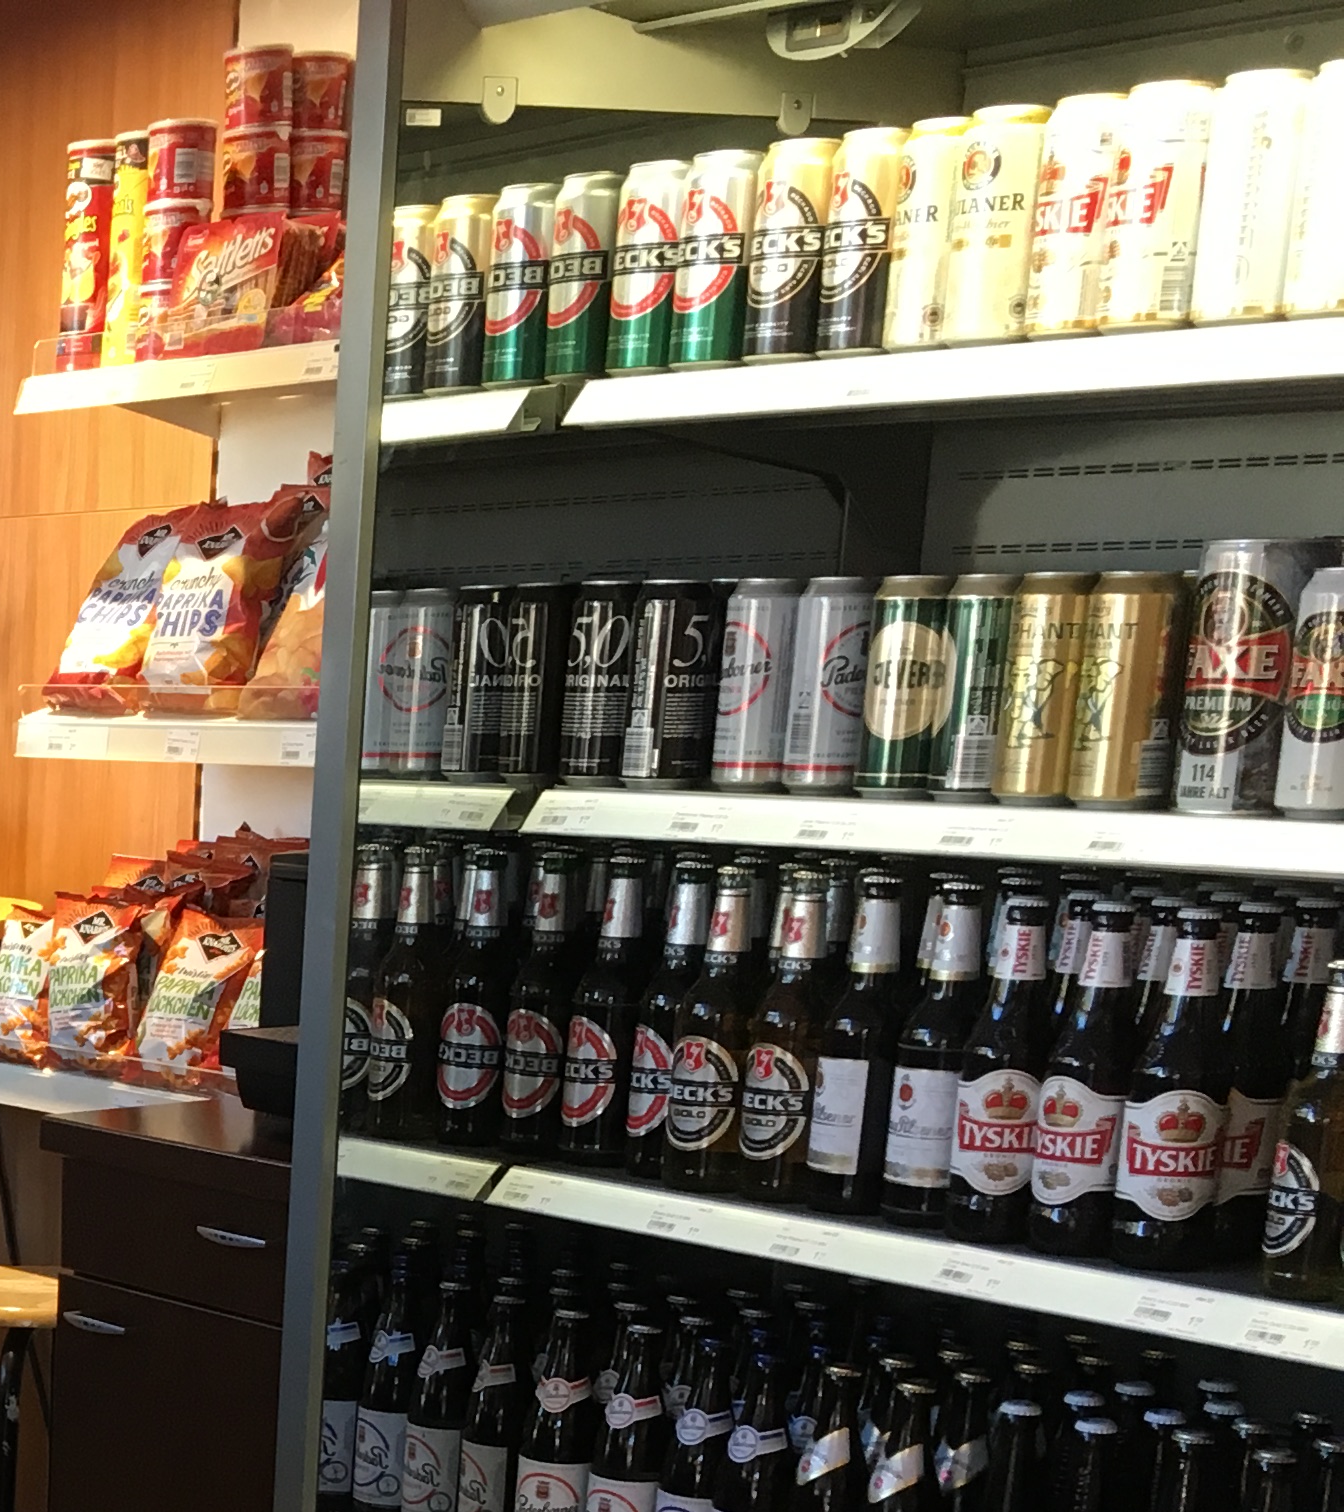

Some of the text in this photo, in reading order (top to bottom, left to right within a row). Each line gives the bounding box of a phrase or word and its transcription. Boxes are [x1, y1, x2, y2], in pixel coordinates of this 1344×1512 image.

[752, 227, 821, 256] ECK'S
[824, 218, 887, 248] ECK'S
[195, 226, 276, 290] Saltletts
[614, 245, 679, 272] ECK'S
[678, 234, 742, 262] ECK'S
[171, 567, 224, 591] crunchy
[77, 604, 148, 627] CHIPS
[568, 615, 630, 668] 5,0
[565, 674, 630, 688] RIGINAL
[1191, 764, 1215, 783] 114
[1209, 786, 1231, 800] ALT
[1013, 928, 1033, 976] TYSKIE
[1059, 921, 1077, 969] TYSKIE
[1083, 932, 1103, 982] TYSKIE
[1295, 931, 1314, 979] TYSKIE
[1185, 941, 1206, 992] TYSKIE
[1232, 935, 1252, 984] TYSKIE
[49, 964, 98, 988] PAPRIKA
[155, 976, 216, 998] PAPRIKA
[564, 1061, 613, 1079] ECK'S
[673, 1109, 706, 1119] GOLD
[745, 1116, 776, 1127] GOLD
[1132, 1139, 1217, 1173] TYSKIE
